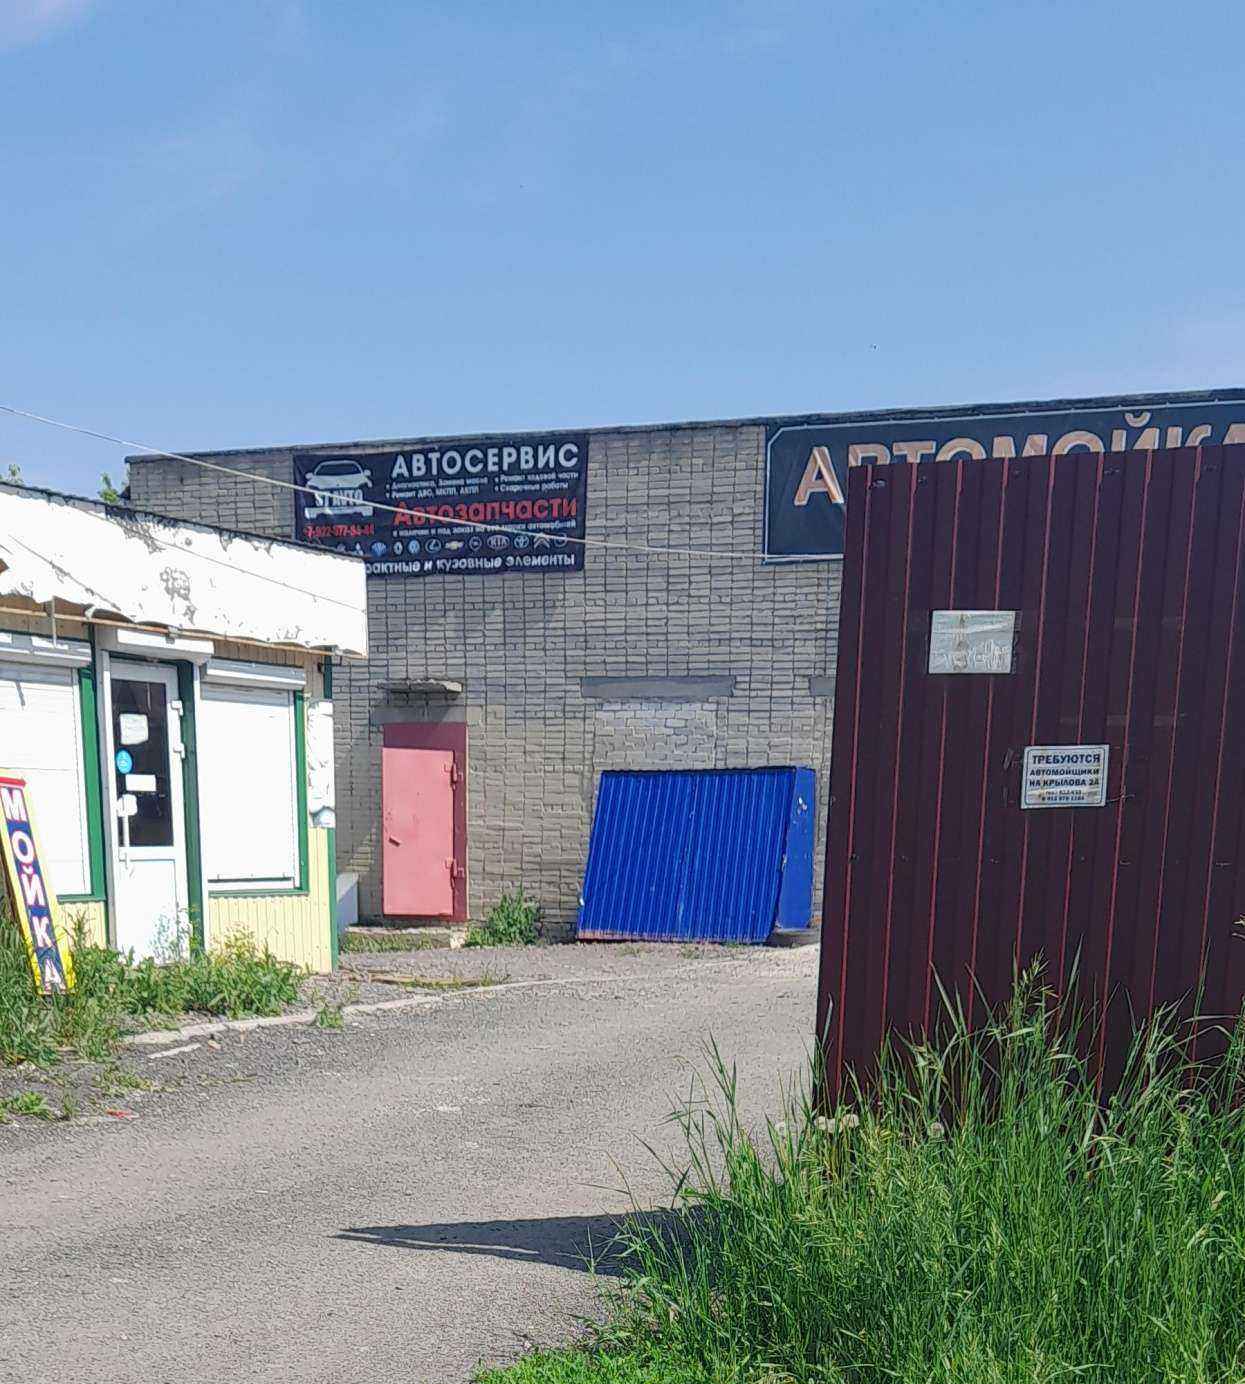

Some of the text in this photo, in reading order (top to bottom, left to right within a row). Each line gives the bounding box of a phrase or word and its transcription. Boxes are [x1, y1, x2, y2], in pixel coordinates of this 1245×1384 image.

[391, 443, 579, 478] АВТОСЕРВИС
[541, 480, 569, 490] работы
[393, 497, 577, 526] Автозапчасти
[366, 553, 576, 574] рактные и кузовные элементы
[1032, 753, 1101, 765] ТРЕБУЮТСЯ
[1029, 779, 1041, 787] НА
[1043, 778, 1087, 787] КРЫЛОВА
[1, 787, 67, 994] МОЙКА
